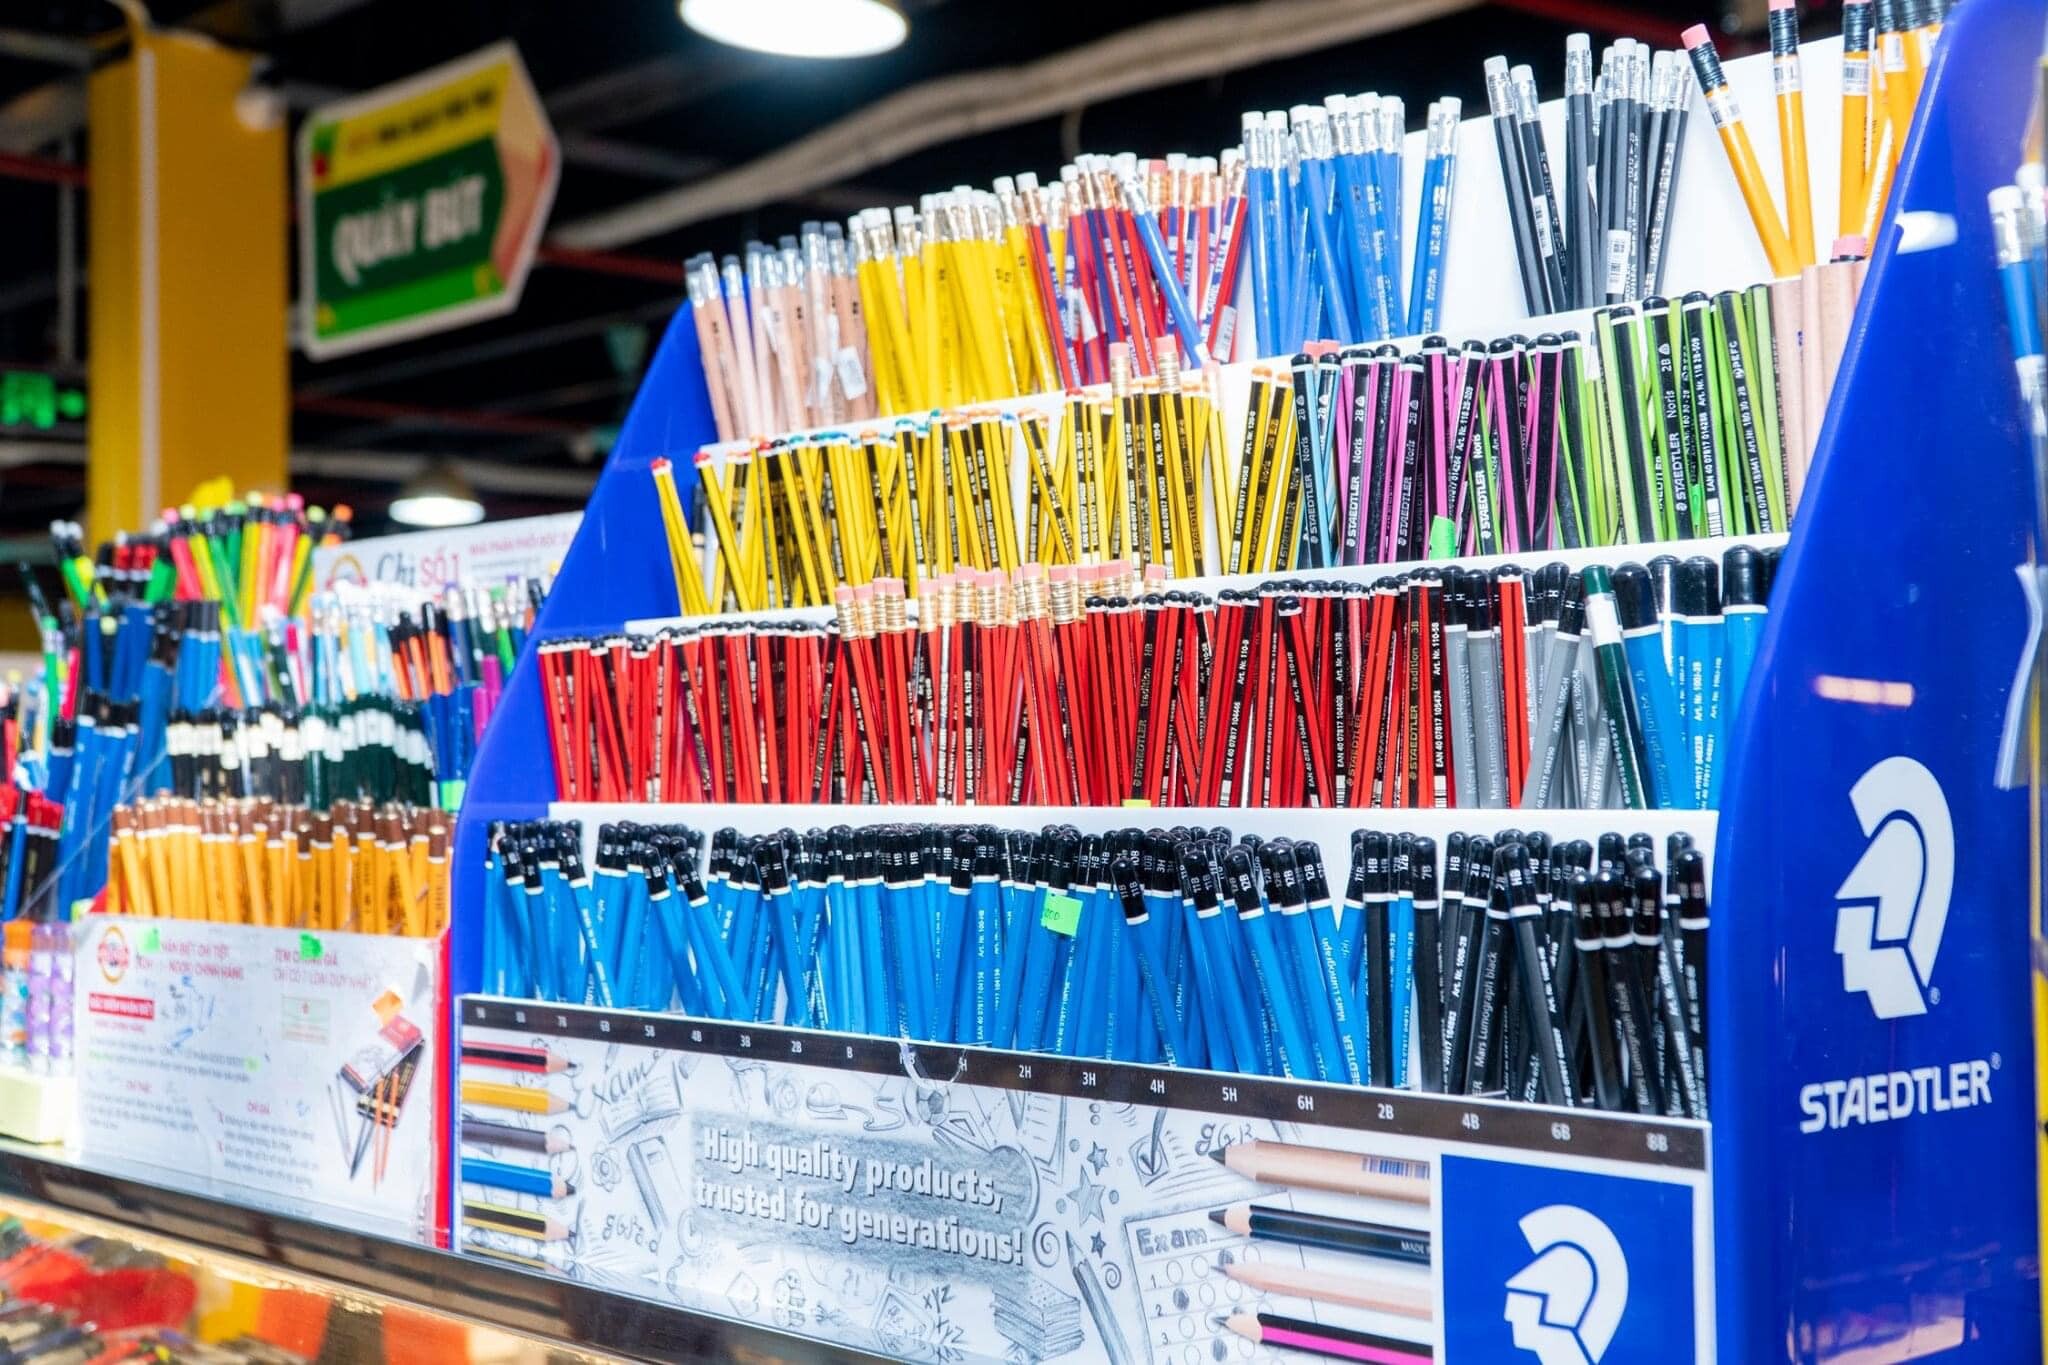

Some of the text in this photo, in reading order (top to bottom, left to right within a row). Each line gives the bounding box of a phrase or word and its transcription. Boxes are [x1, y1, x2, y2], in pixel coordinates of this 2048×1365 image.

[1697, 391, 1706, 406] Art.
[1661, 358, 1684, 500] STAEDTLER Noris 2B
[1728, 340, 1767, 508] 07817 PEFC
[1455, 437, 1464, 450] Art.
[1702, 440, 1712, 463] 07817
[1297, 408, 1317, 534] STAEDTLER Noris 2B
[1347, 409, 1364, 537] STAEDTLER Noris 2B
[1399, 412, 1417, 536] STAEDTLER Noris 2B
[1472, 433, 1489, 529] STAEDTLER Noris
[1706, 475, 1715, 491] EAN
[1431, 622, 1439, 646] 110-5B
[1286, 651, 1296, 676] 110-HB
[1409, 620, 1418, 769] STAEDTLER tradition 3B
[1433, 690, 1441, 715] 105474
[1133, 642, 1152, 776] STAEDTLER tradition HB
[1694, 706, 1702, 720] Art.
[1228, 727, 1237, 747] 07817
[1434, 718, 1442, 739] 07817
[1538, 776, 1548, 798] 07817
[1552, 720, 1560, 732] Art.
[1558, 676, 1569, 704] 100C-H
[1227, 748, 1234, 757] 40
[1301, 741, 1311, 762] 07817
[1336, 742, 1344, 750] 40
[1348, 714, 1362, 776] STAEDTLER
[1435, 741, 1442, 750] 40
[1484, 714, 1499, 772] Lumograph
[1225, 758, 1233, 772] EAN
[1305, 762, 1312, 771] 40
[1435, 751, 1443, 767] EAN
[1307, 772, 1315, 787] EAN
[1592, 766, 1602, 790] 07817
[1703, 763, 1711, 788] 07817
[1489, 774, 1499, 799] Mars
[911, 852, 918, 864] HB
[944, 848, 952, 860] HB
[962, 858, 970, 870] HB
[1092, 856, 1099, 868] HB
[1102, 852, 1109, 863] HB
[1450, 856, 1460, 871] HB
[1157, 859, 1165, 872] 3H
[1304, 865, 1314, 880] 12B
[1367, 859, 1378, 872] HB
[1422, 866, 1432, 879] 7B
[1470, 863, 1480, 876] 2B
[1240, 874, 1250, 890] 12B
[1284, 871, 1294, 887] 12B
[1509, 869, 1522, 885] HB
[1320, 936, 1346, 1021] Mars Lumograph
[1452, 982, 1461, 996] Art.
[1475, 951, 1497, 1067] Mars Lumograph black
[645, 1025, 655, 1037] 5B
[692, 1030, 702, 1042] 4B
[740, 1035, 751, 1048] 3B
[792, 1040, 802, 1053] 2B
[846, 1046, 853, 1059] B
[1019, 1065, 1031, 1079] 2H
[1082, 1072, 1096, 1087] 3H
[1150, 1079, 1165, 1094] 4H
[1222, 1087, 1237, 1102] 5H
[1298, 1096, 1314, 1112] 6H
[1378, 1104, 1394, 1120] 2B
[1462, 1114, 1480, 1130] 4B
[1552, 1124, 1570, 1141] 6B
[1646, 1133, 1668, 1151] 8B
[1800, 1063, 1992, 1134] STAEDTLER
[704, 1128, 1004, 1214] High quality products,
[696, 1181, 1024, 1266] trusted for generations!
[1136, 1226, 1208, 1256] Exam
[1400, 1240, 1424, 1254] MADE
